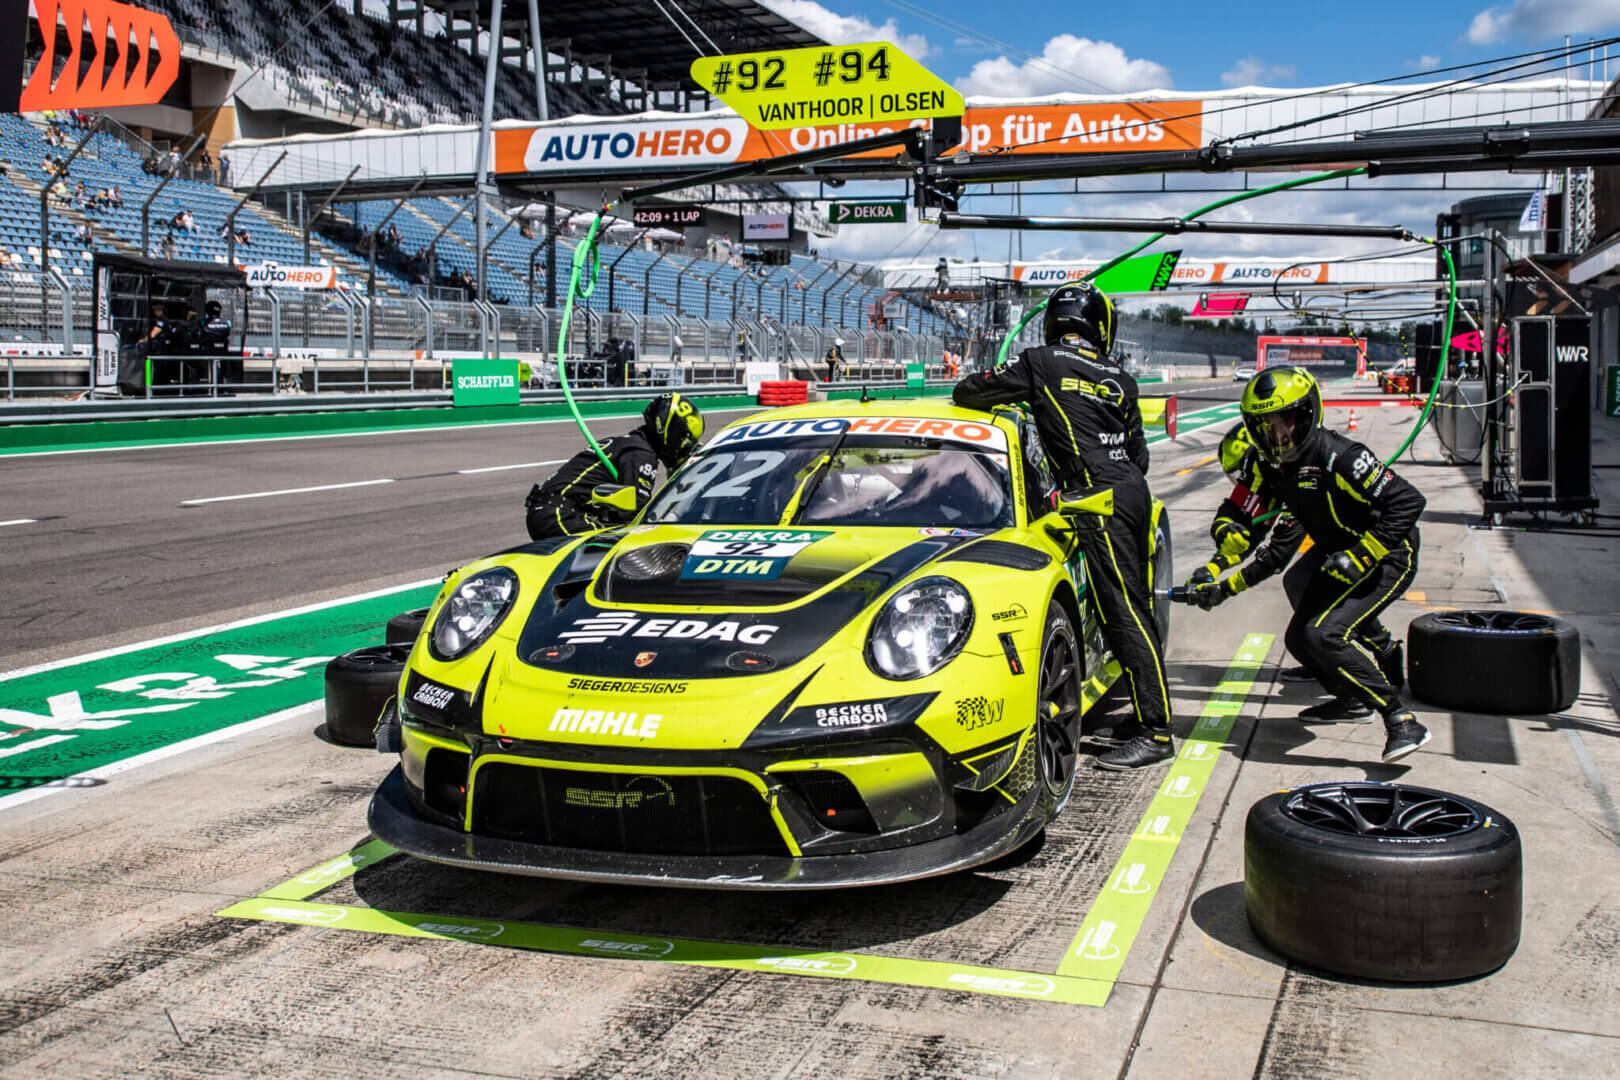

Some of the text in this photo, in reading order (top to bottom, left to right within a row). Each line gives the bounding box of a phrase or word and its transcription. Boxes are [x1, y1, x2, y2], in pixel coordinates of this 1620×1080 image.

[712, 46, 891, 94] #92 #94
[758, 97, 863, 122] VANTHOOR
[880, 90, 945, 113] OLSEN
[1001, 114, 1052, 146] für
[1059, 112, 1164, 144] Autos
[540, 127, 731, 162] AUTOHERO
[634, 211, 663, 223] 42:09
[681, 211, 701, 222] LAP
[855, 205, 894, 219] DEKRA
[250, 270, 323, 283] AUTOHERO
[1232, 267, 1312, 279] AUTOHERO
[458, 375, 515, 389] SCHAEFFLER
[715, 418, 993, 446] AUTOHERO
[674, 450, 787, 499] 92
[708, 531, 813, 541] DEKRA
[715, 542, 777, 556] 92
[693, 559, 775, 575] DTM
[992, 609, 1018, 621] SSR
[632, 619, 780, 645] EDAG
[419, 683, 455, 701] BECKER
[567, 678, 689, 694] SIEGERDESIGNS
[413, 691, 448, 710] CARBON
[816, 703, 884, 718] BECKER
[548, 708, 664, 738] MAHLE
[817, 711, 888, 728] CARBON
[565, 787, 644, 808] SSR
